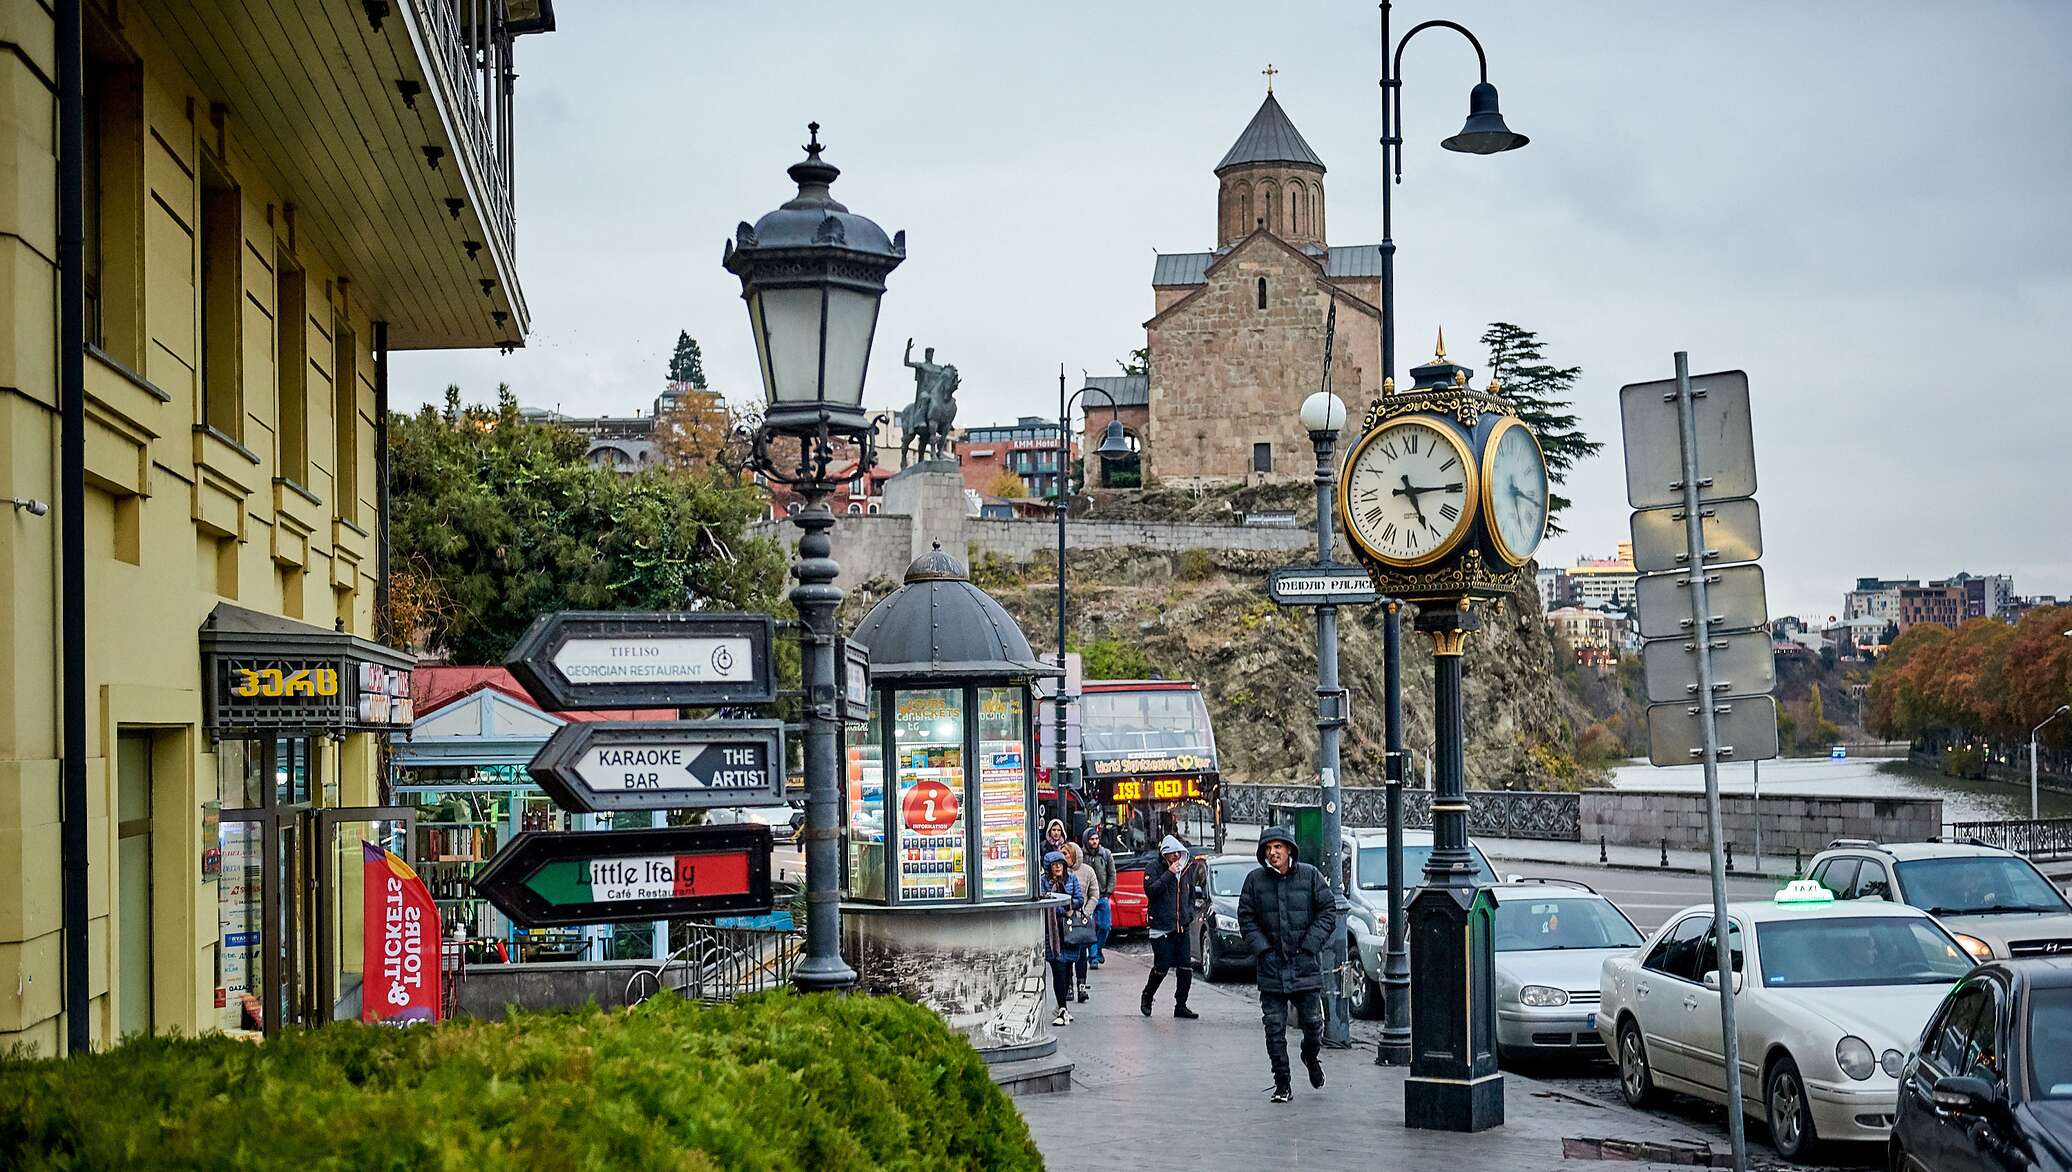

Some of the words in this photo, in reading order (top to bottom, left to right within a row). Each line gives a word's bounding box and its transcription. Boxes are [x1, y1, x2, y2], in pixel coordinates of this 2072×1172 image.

[610, 647, 659, 657] TIFLISO
[566, 666, 627, 677] GEORGIAN
[630, 665, 702, 677] RESTAURANT
[599, 749, 682, 766] KARAOKE
[722, 749, 755, 765] THE
[624, 773, 660, 788] BAR
[711, 770, 768, 788] ARTIST
[1154, 780, 1182, 798] RED
[576, 860, 639, 886] Little
[644, 860, 696, 888] Italy
[607, 889, 632, 899] Café
[638, 887, 696, 898] Restaurant
